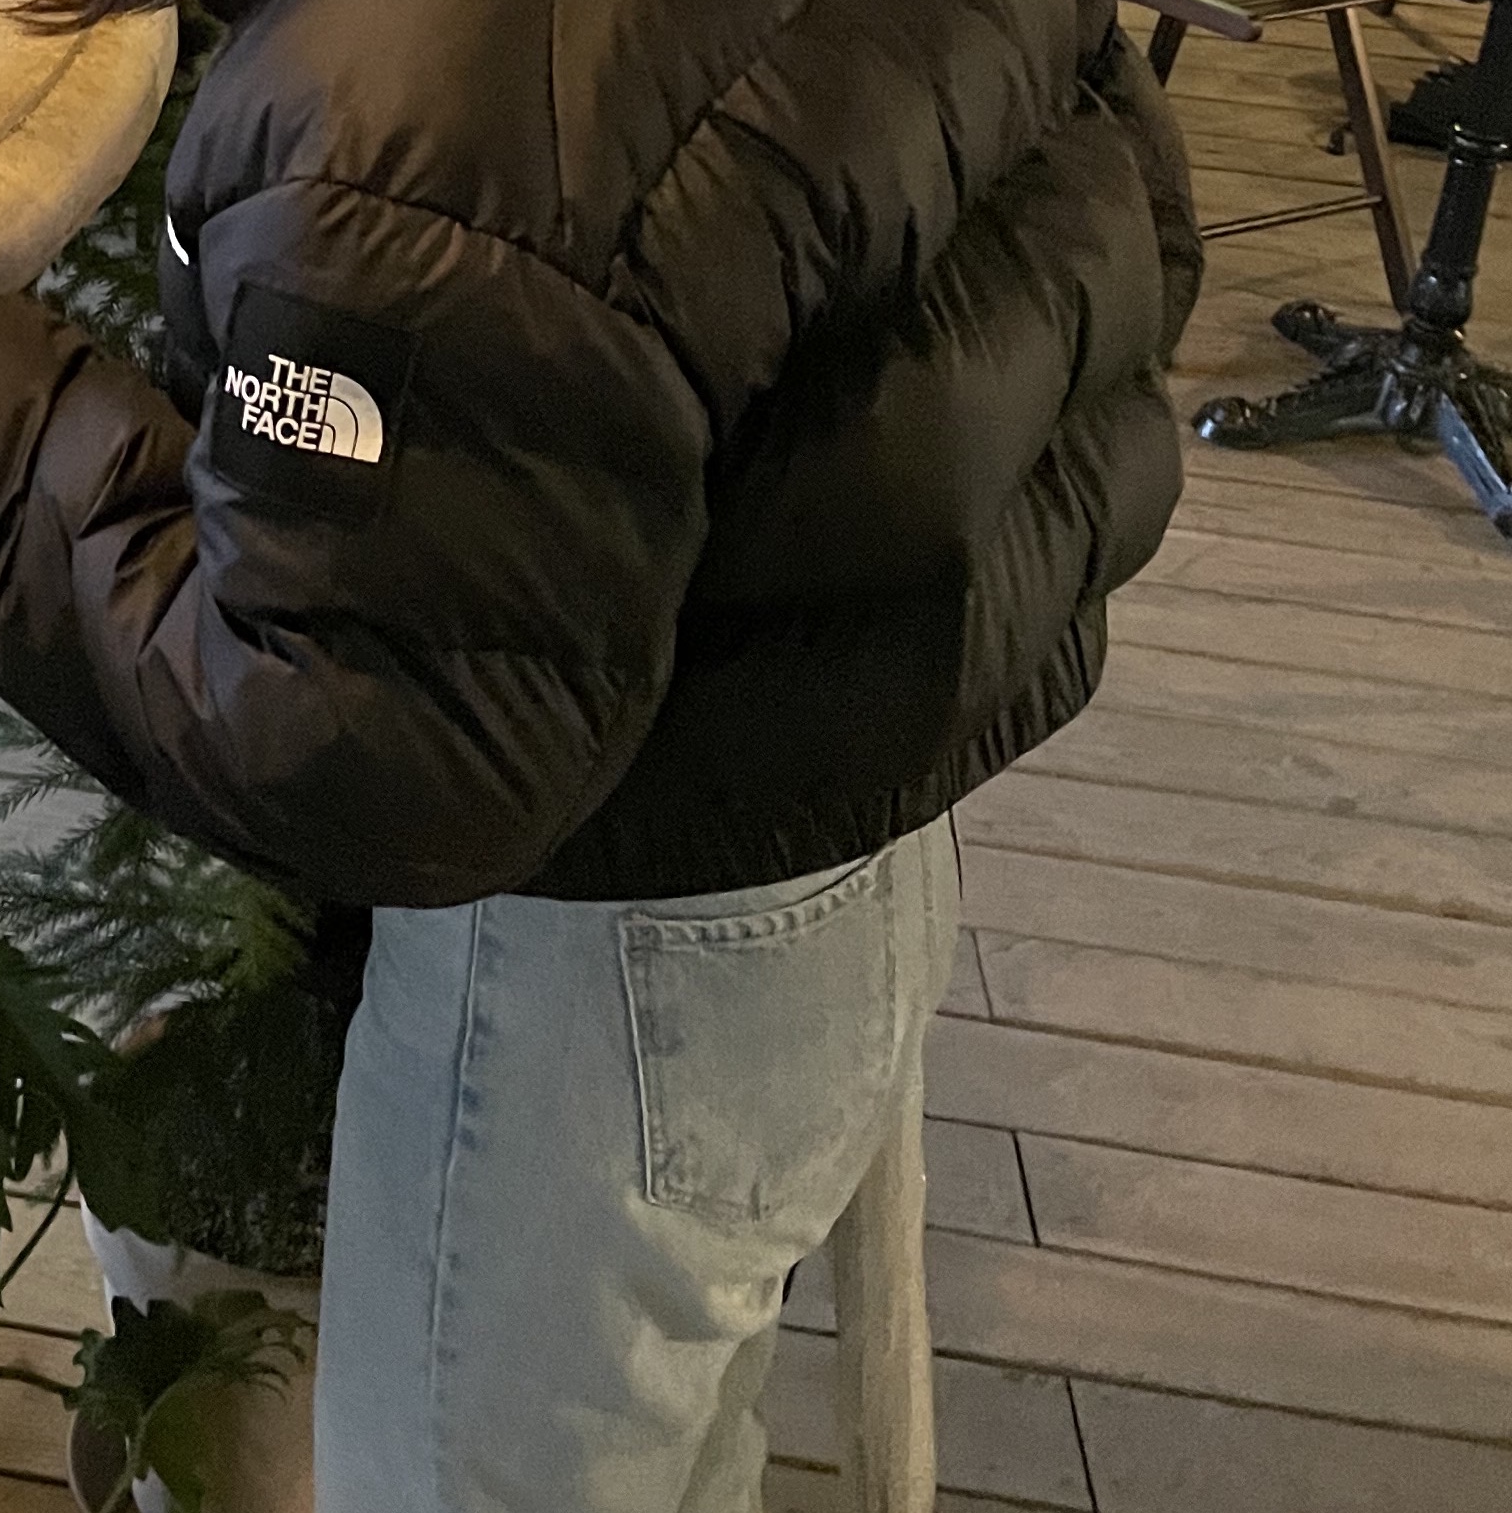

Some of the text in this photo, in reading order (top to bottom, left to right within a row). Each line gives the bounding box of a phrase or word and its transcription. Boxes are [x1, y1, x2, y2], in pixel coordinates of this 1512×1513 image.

[225, 365, 327, 422] NORTH
[268, 353, 331, 395] THE
[242, 403, 322, 451] FACE
